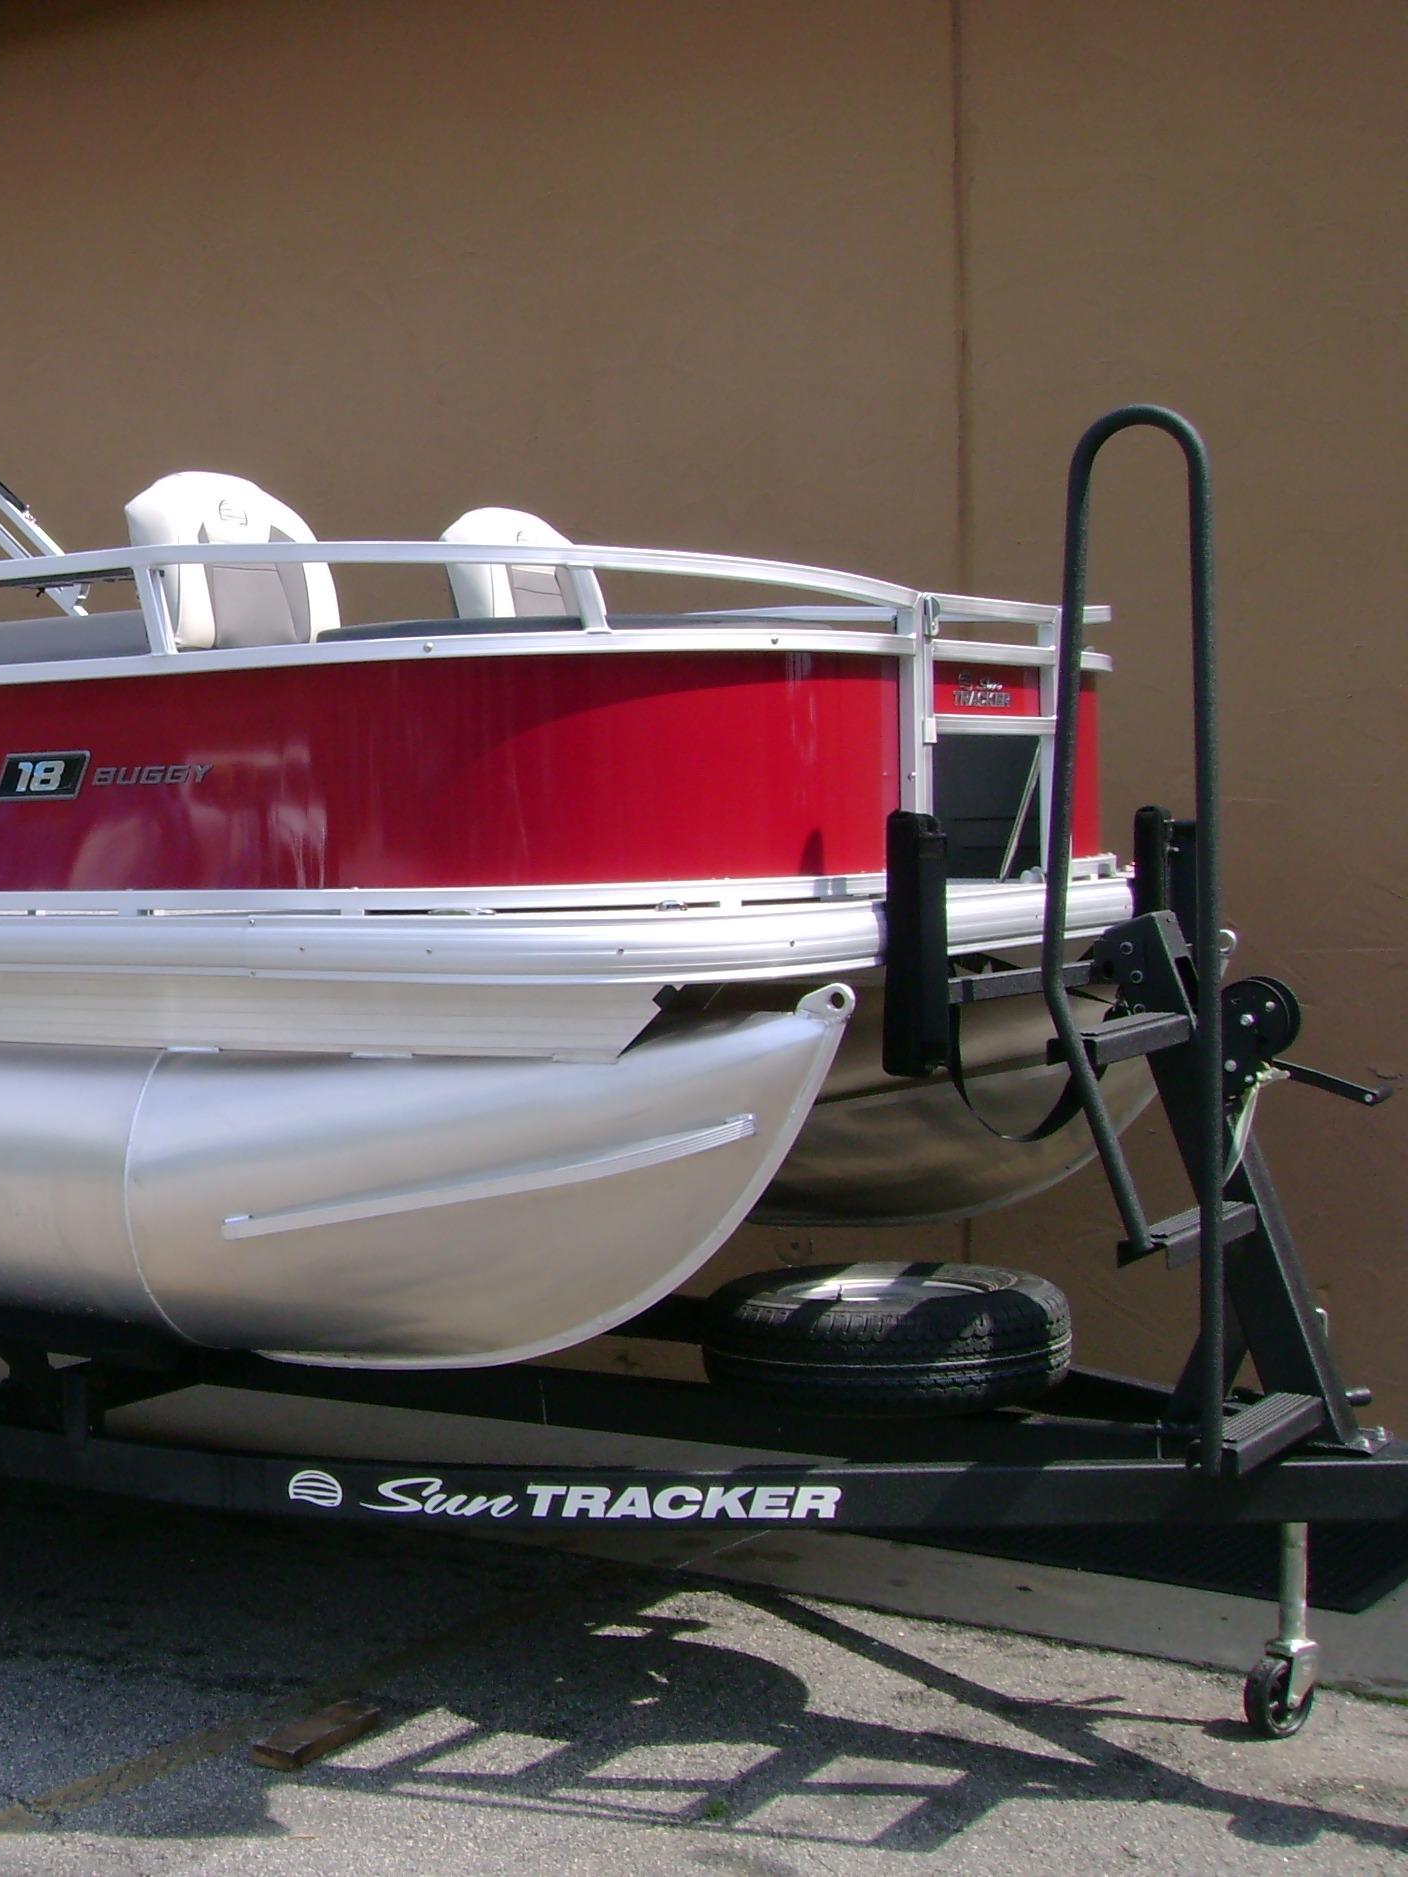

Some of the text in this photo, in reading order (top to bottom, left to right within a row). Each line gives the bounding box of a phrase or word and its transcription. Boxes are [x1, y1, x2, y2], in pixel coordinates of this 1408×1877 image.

[16, 761, 65, 792] 18
[93, 764, 213, 786] BUGGY
[359, 1477, 842, 1519] Sun TRACKER
